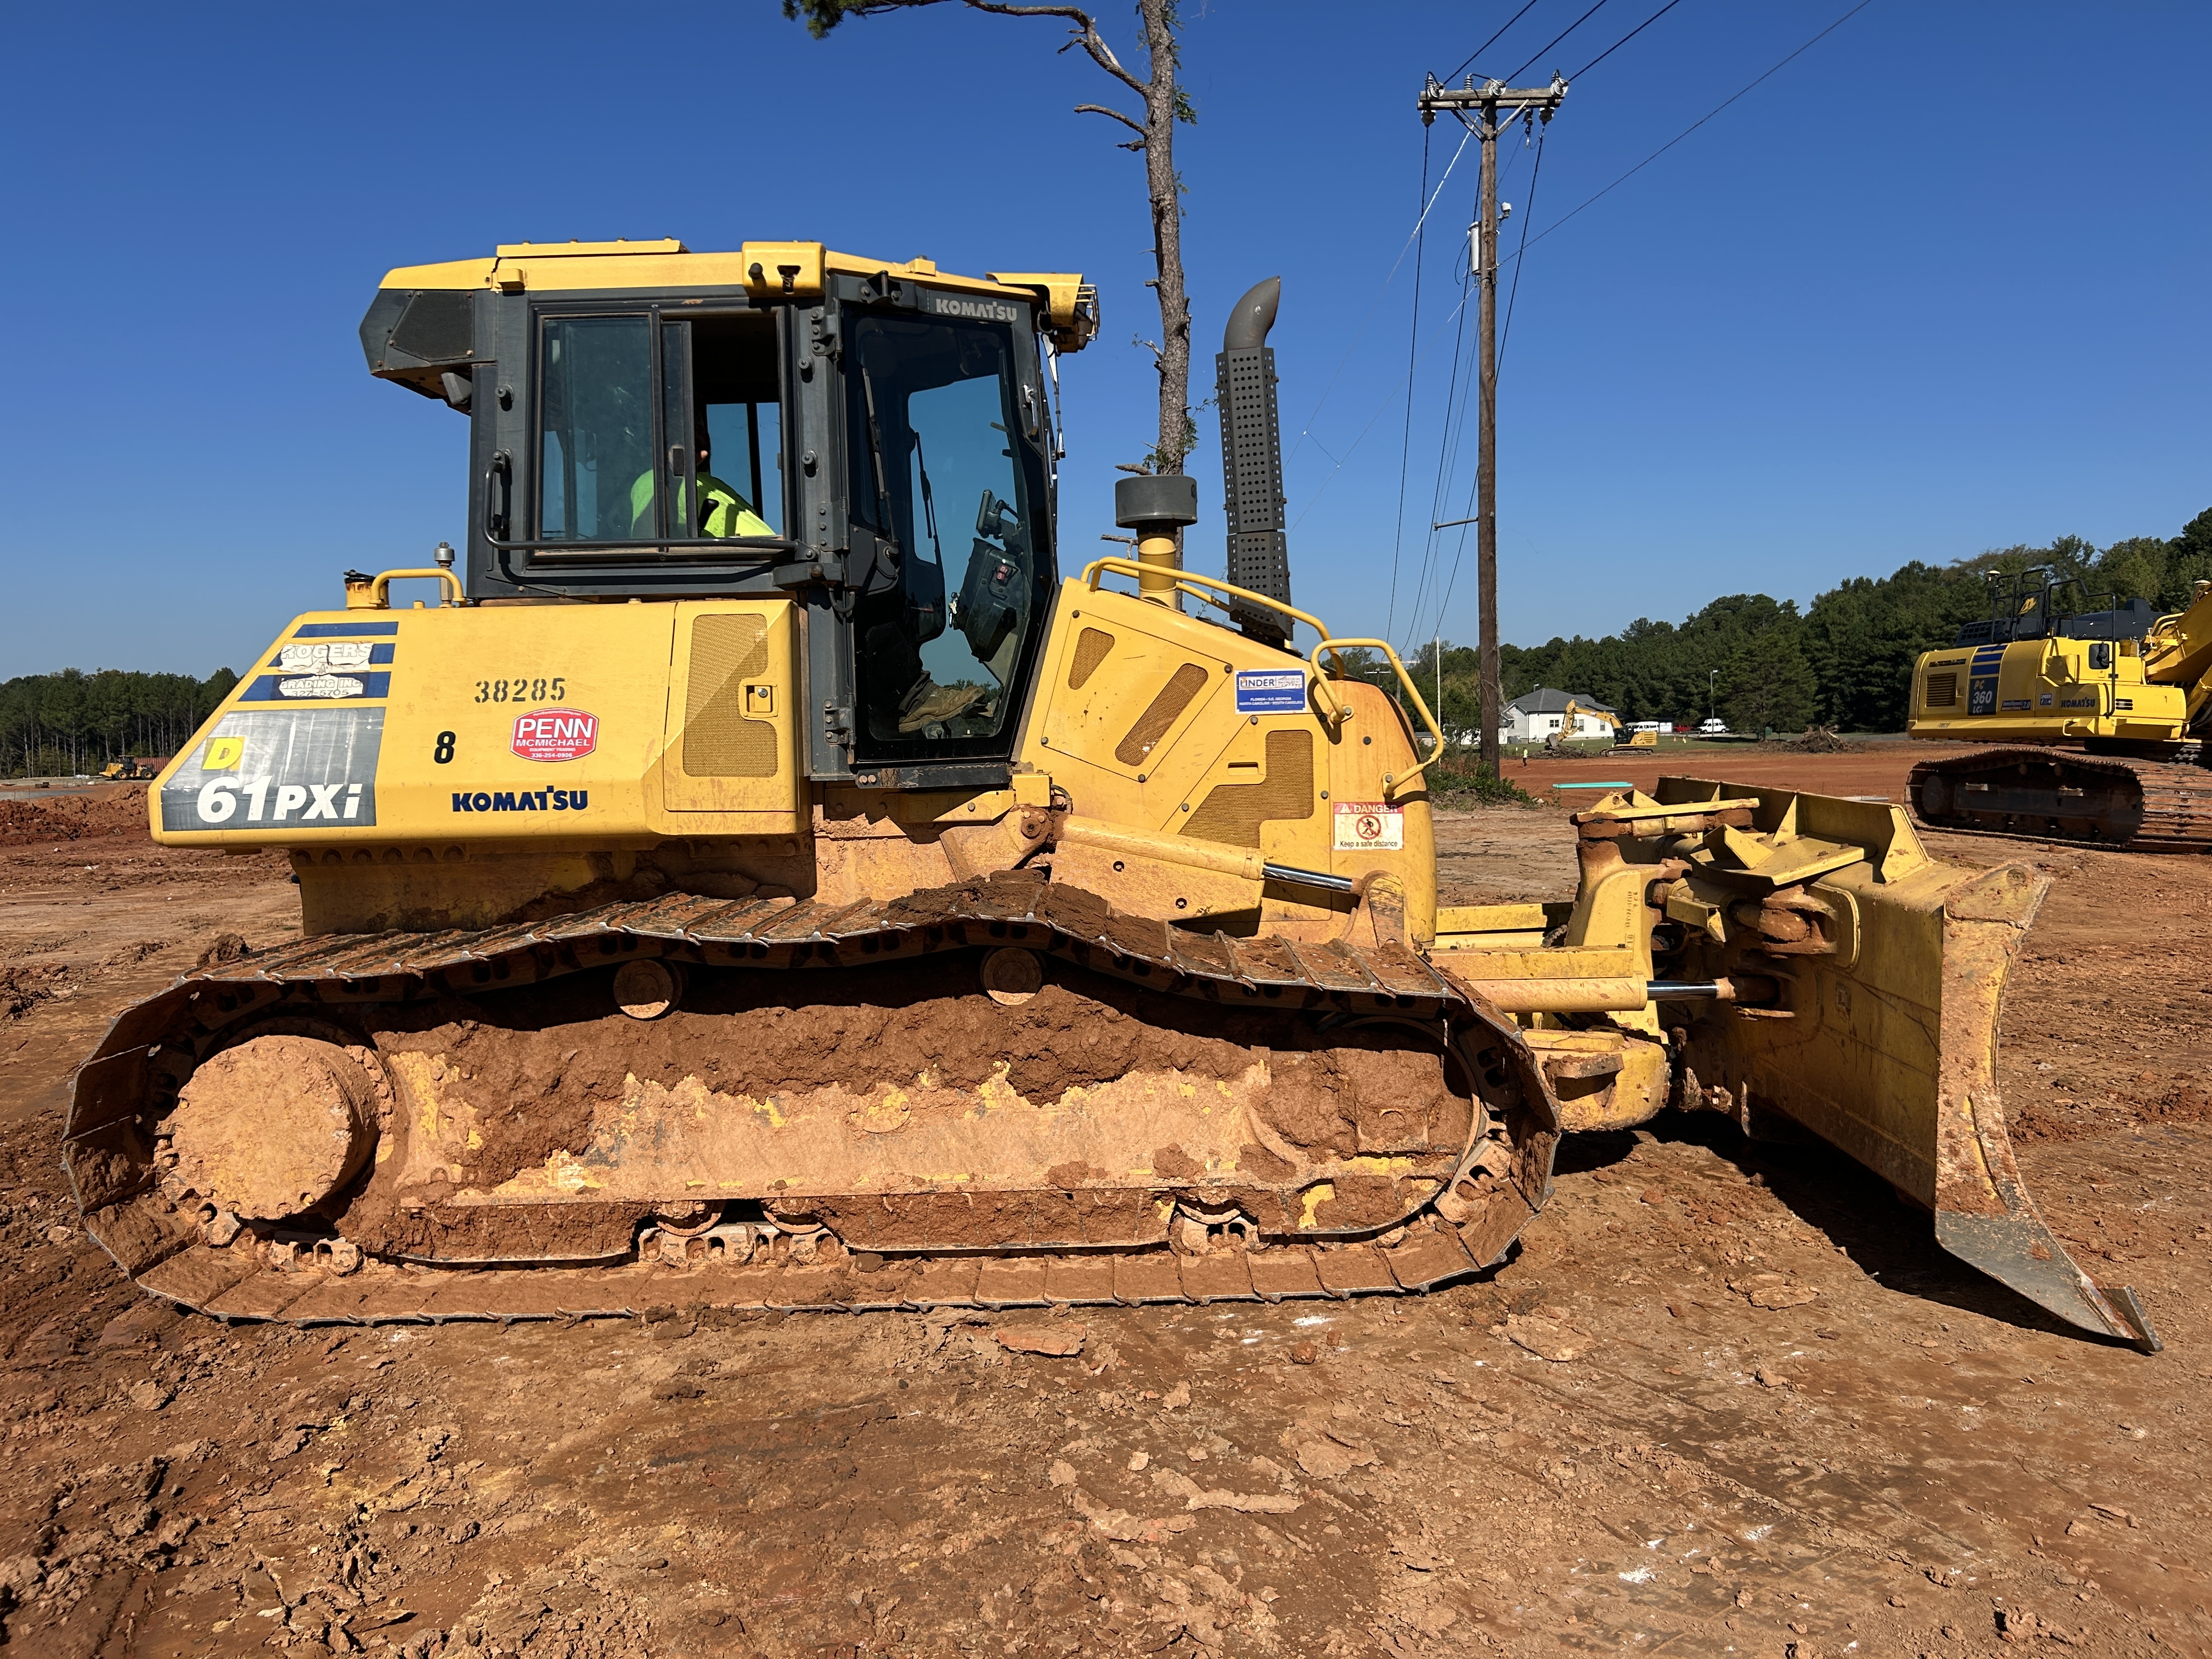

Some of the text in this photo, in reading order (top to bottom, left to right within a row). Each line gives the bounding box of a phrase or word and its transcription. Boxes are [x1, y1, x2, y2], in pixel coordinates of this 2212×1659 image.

[936, 298, 1017, 321] KOMATSU
[280, 644, 373, 659] ROGERS
[280, 679, 335, 690] GRADING
[475, 678, 566, 704] 38285
[1240, 679, 1275, 687] LINDER
[1974, 680, 1985, 690] PC
[1972, 690, 1993, 704] 360
[2061, 697, 2096, 708] KOMATSU
[517, 718, 593, 738] PENN
[202, 738, 244, 770] D
[433, 731, 456, 764] 8
[197, 775, 363, 823] 61PXi
[452, 786, 588, 812] KOMATSU
[1353, 804, 1398, 813] DANGER
